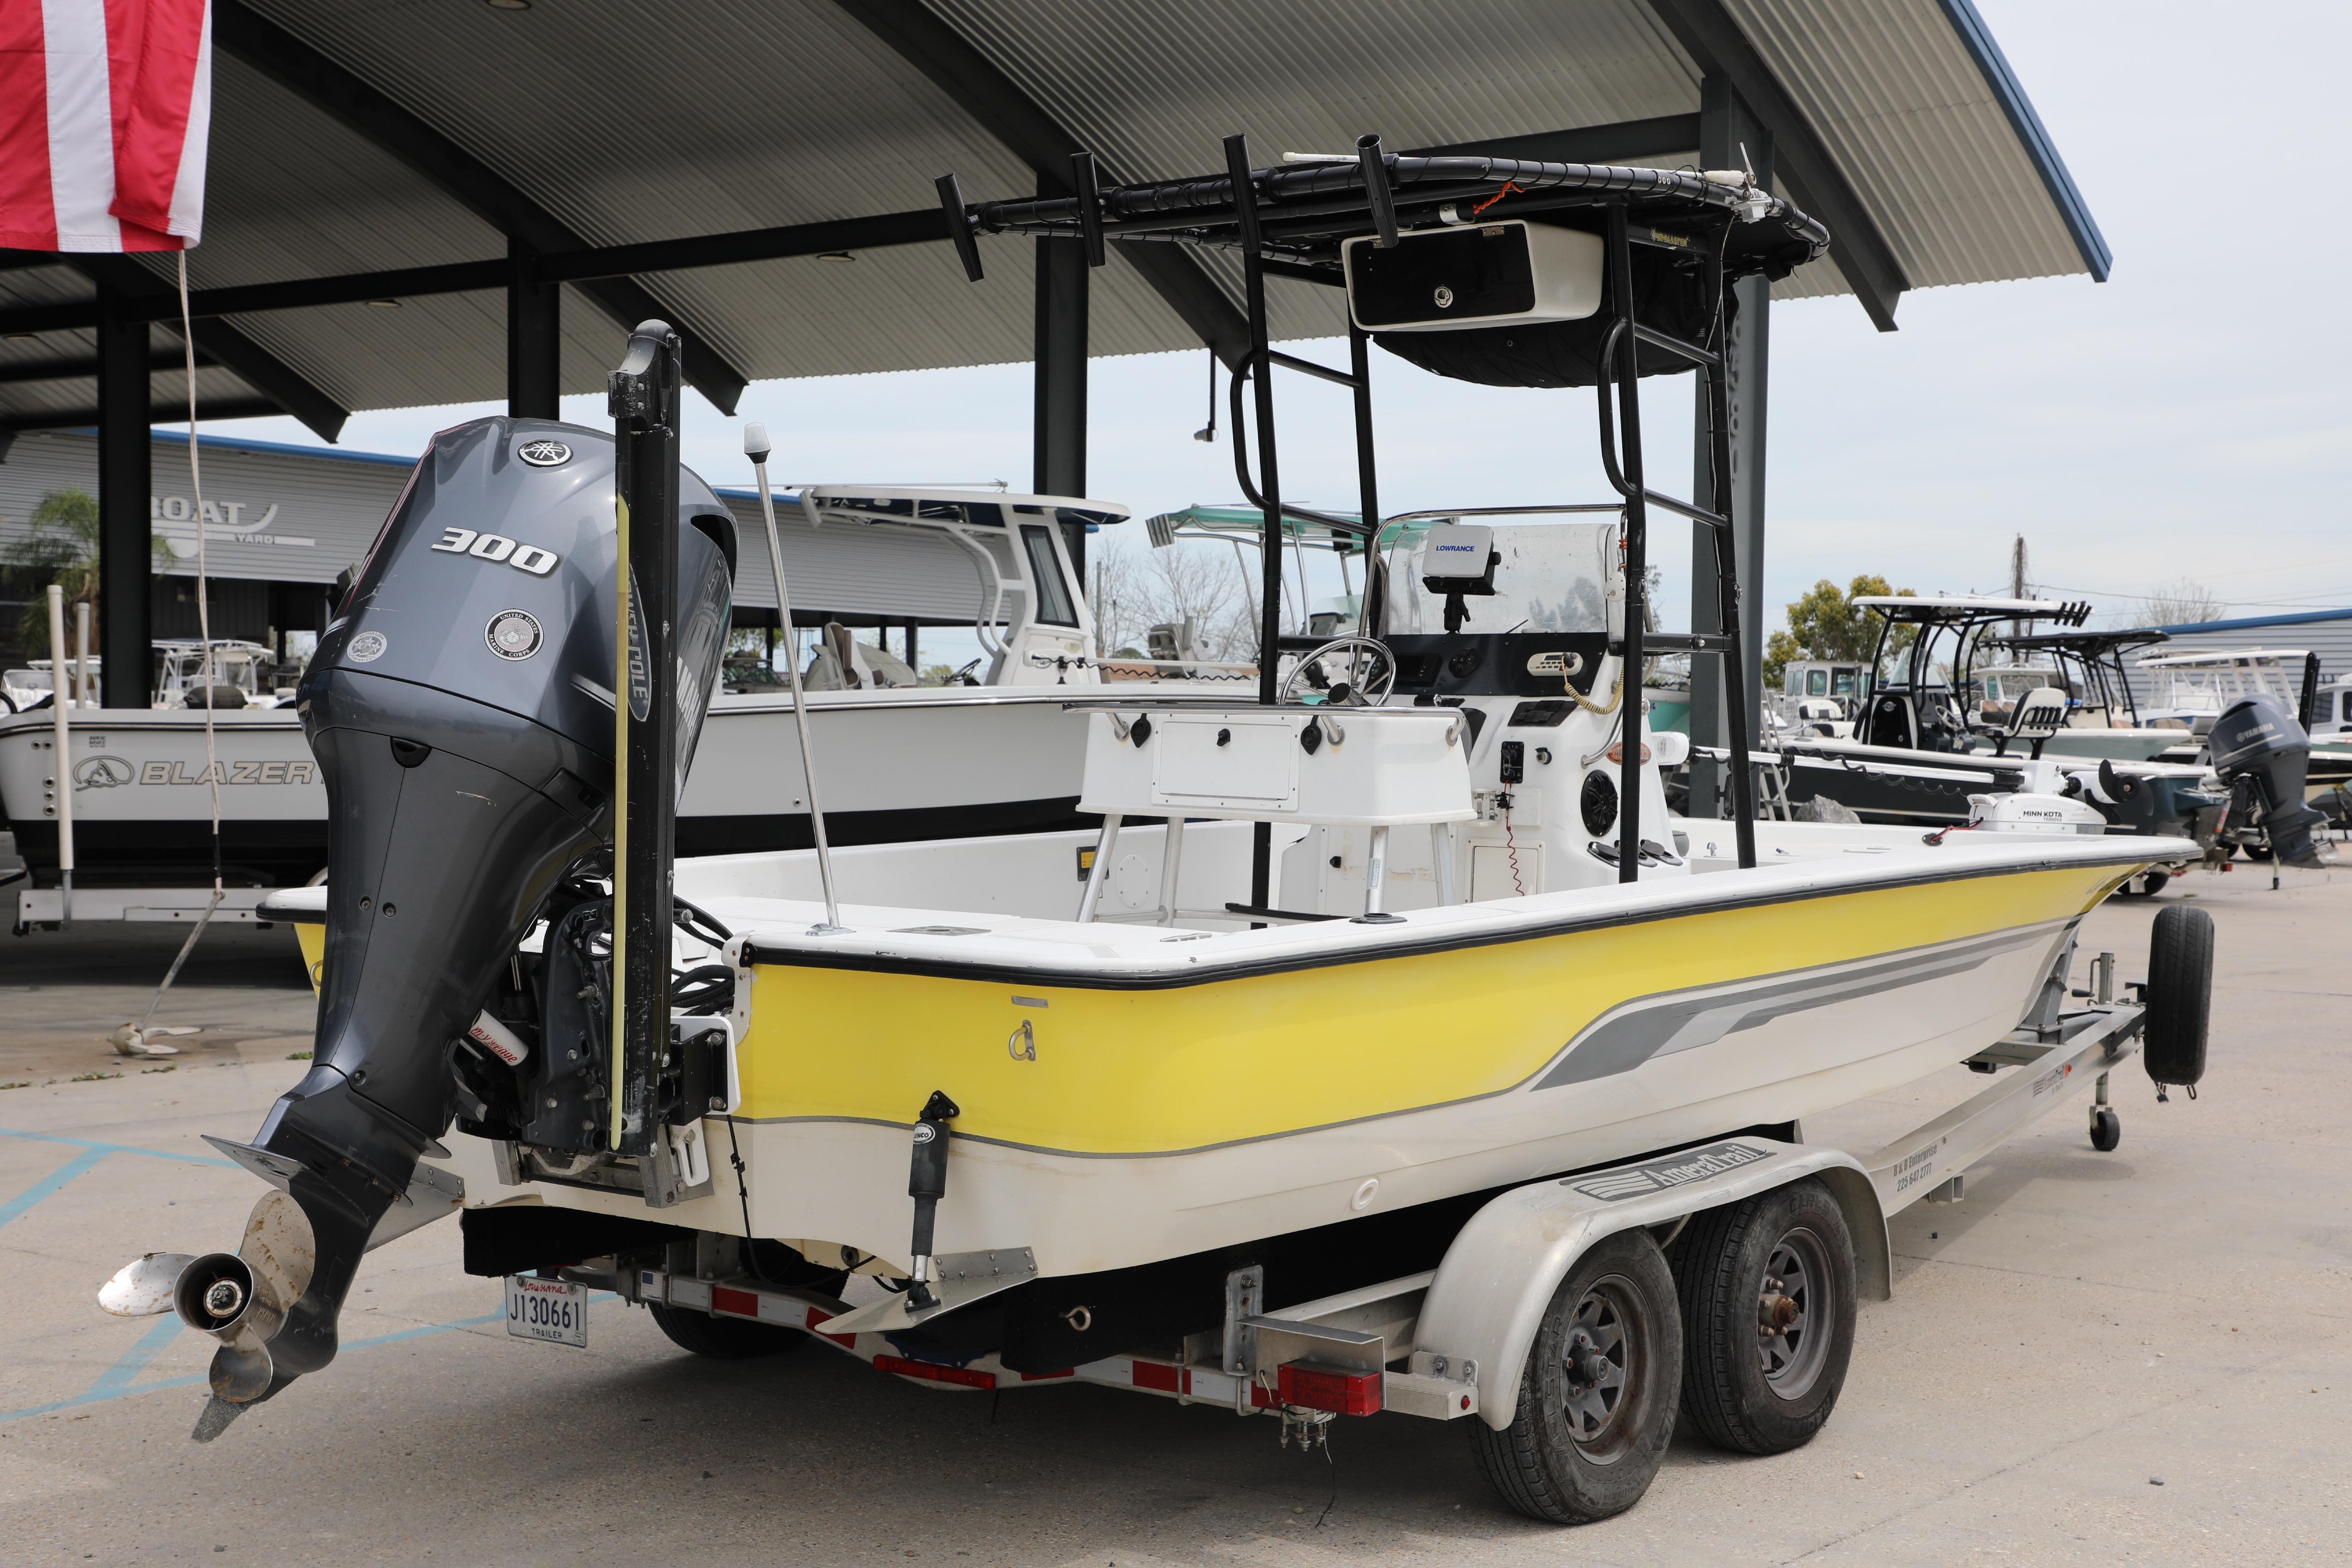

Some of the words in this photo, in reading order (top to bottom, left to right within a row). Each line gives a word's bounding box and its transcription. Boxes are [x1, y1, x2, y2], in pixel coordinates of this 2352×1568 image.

[236, 534, 273, 544] YARD
[430, 526, 558, 574] 300
[524, 616, 539, 634] STATES
[489, 633, 505, 654] MARINE
[509, 648, 530, 657] CORPS
[2245, 723, 2275, 739] YAMAHA
[140, 761, 315, 784] BLAZER
[1644, 1145, 1766, 1186] AmeraTrail
[1893, 1164, 1898, 1177] B
[1899, 1165, 1903, 1174] &
[1904, 1159, 1908, 1171] B
[1909, 1144, 1937, 1168] Enterprise
[1897, 1176, 1908, 1192] 225
[1909, 1168, 1919, 1185] 647
[524, 1280, 567, 1294] Louisiana
[510, 1293, 579, 1331] J130661
[531, 1328, 563, 1340] TRAILER
